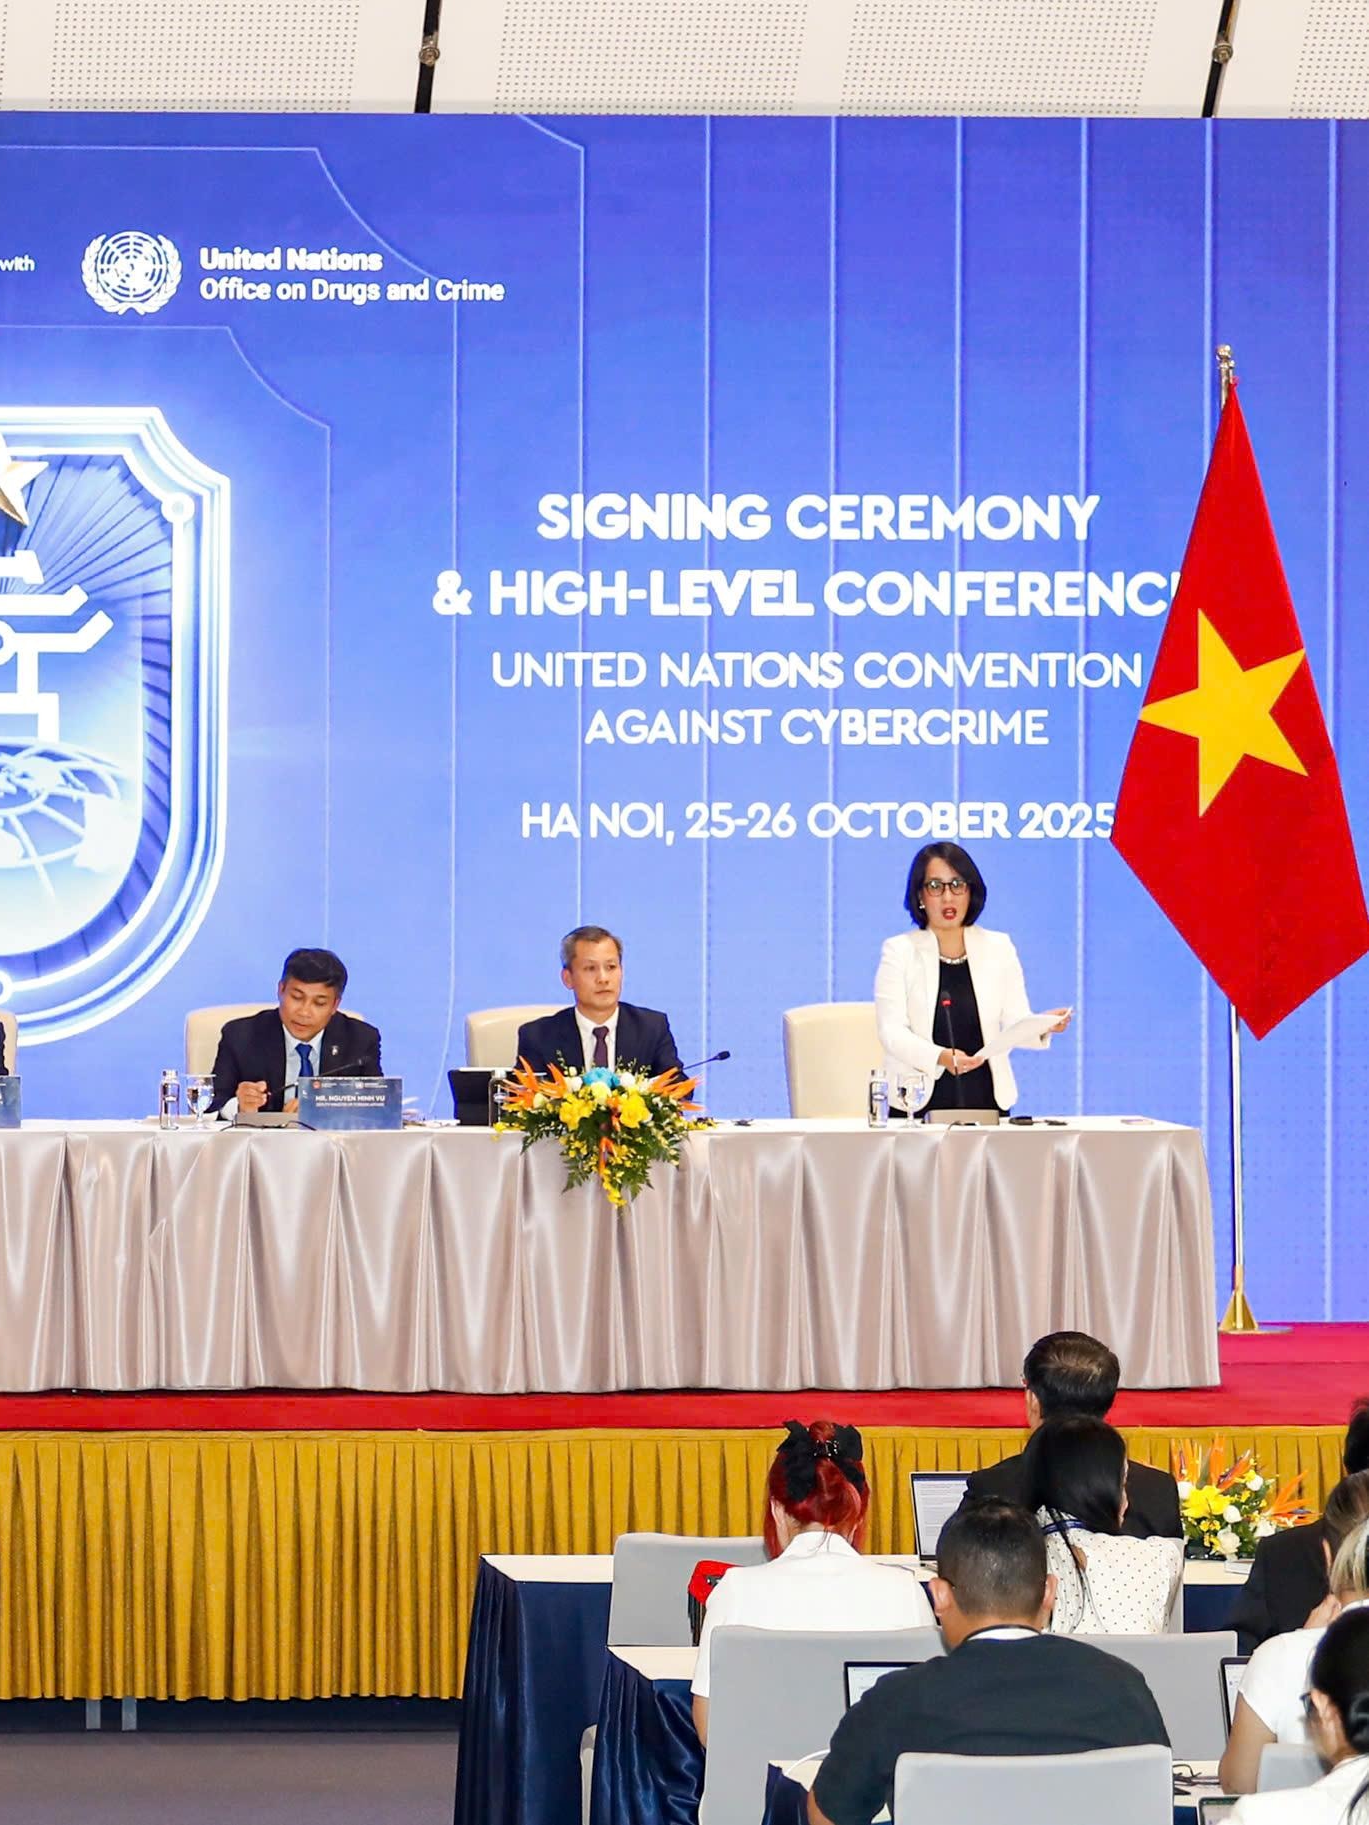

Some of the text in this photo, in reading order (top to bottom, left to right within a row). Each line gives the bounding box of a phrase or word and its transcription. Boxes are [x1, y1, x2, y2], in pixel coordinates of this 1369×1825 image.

[200, 246, 383, 271] United Nations
[200, 277, 506, 306] Office on Drugs and Crime
[537, 493, 1100, 540] SIGNING CEREMONY
[432, 569, 1181, 617] & HIGH-LEVEL CONFERENC
[492, 652, 1142, 689] UNITED NATIONS CONVENTION
[584, 708, 1049, 745] AGAINST CYBERCRIME
[522, 801, 1116, 846] HA NOI, 25-26 OCTOBER 2025
